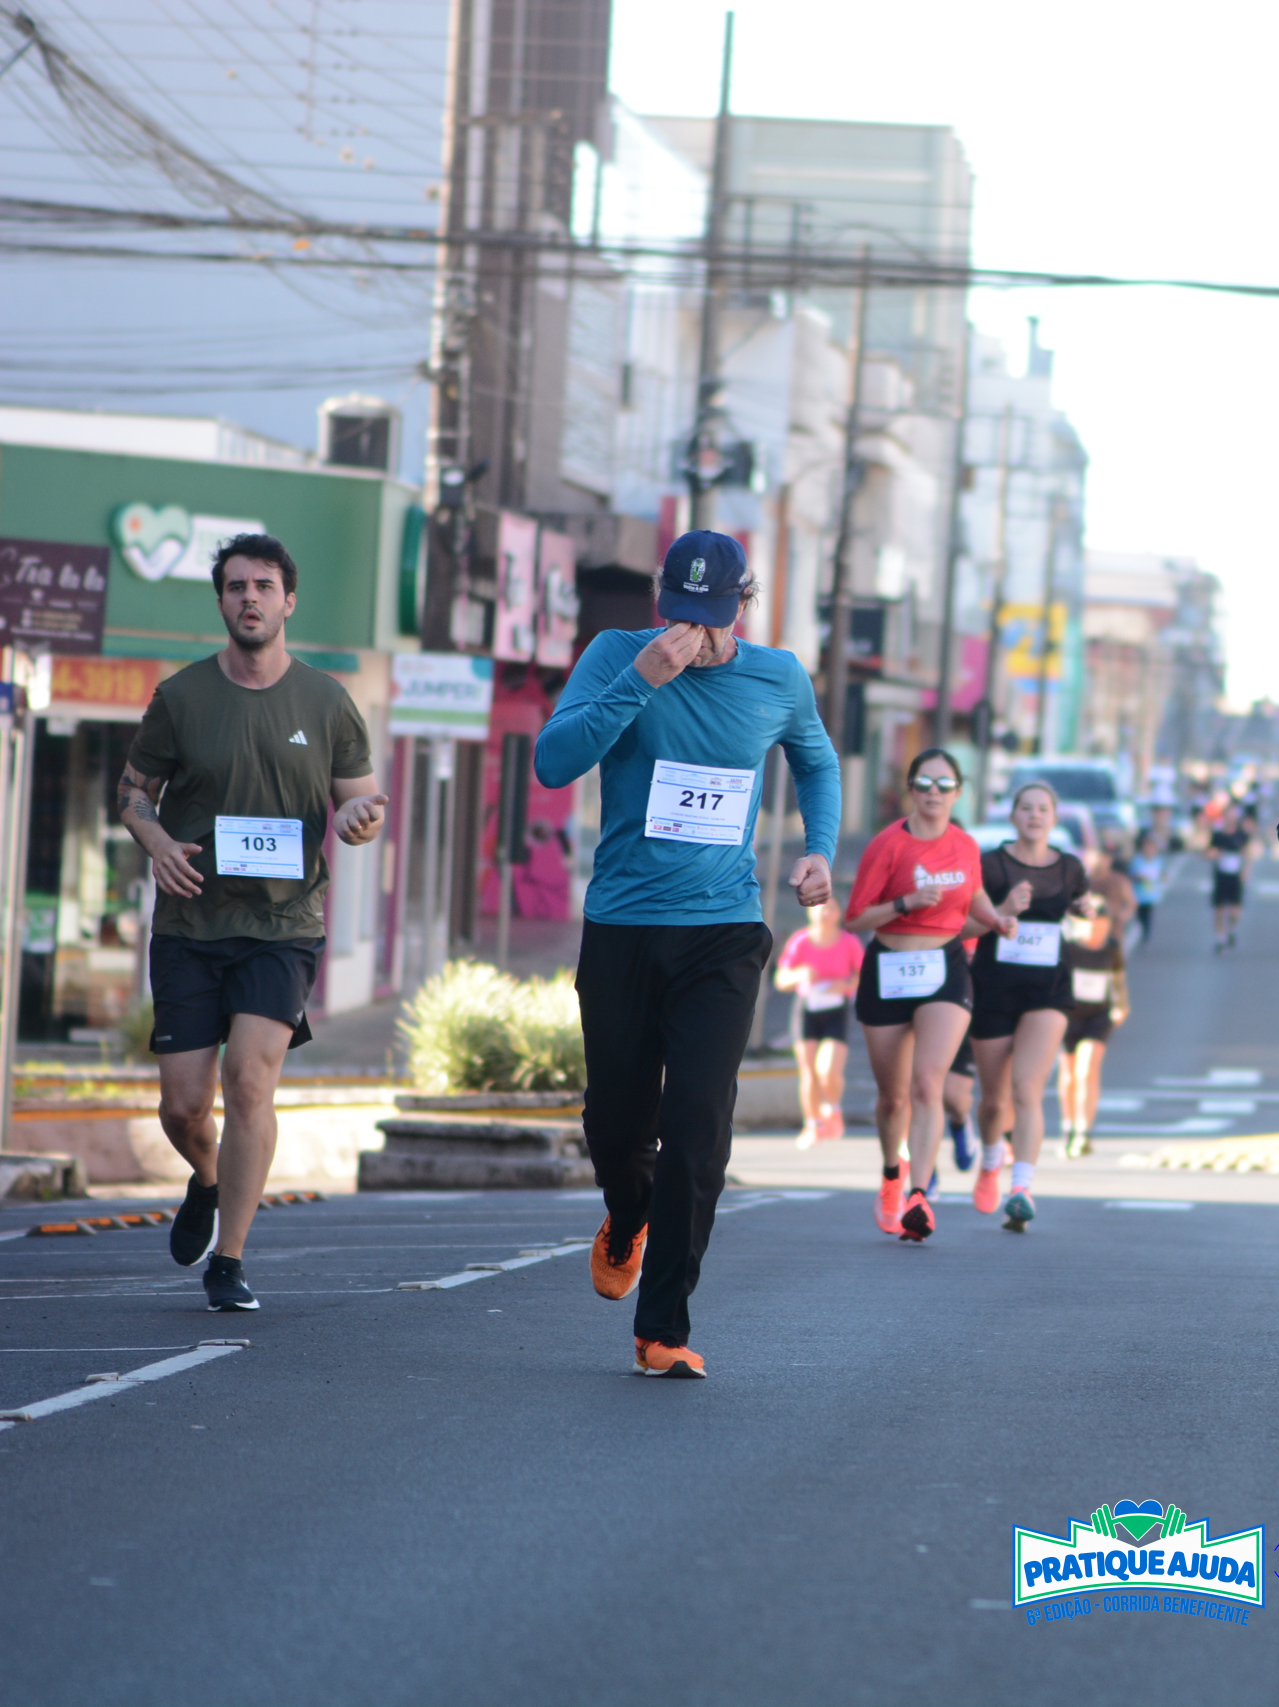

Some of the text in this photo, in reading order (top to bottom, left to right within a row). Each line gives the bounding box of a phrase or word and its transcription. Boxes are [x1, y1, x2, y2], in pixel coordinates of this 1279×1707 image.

[679, 790, 724, 811] 217
[241, 836, 277, 852] 103
[1017, 935, 1043, 946] 047
[898, 965, 926, 977] 137
